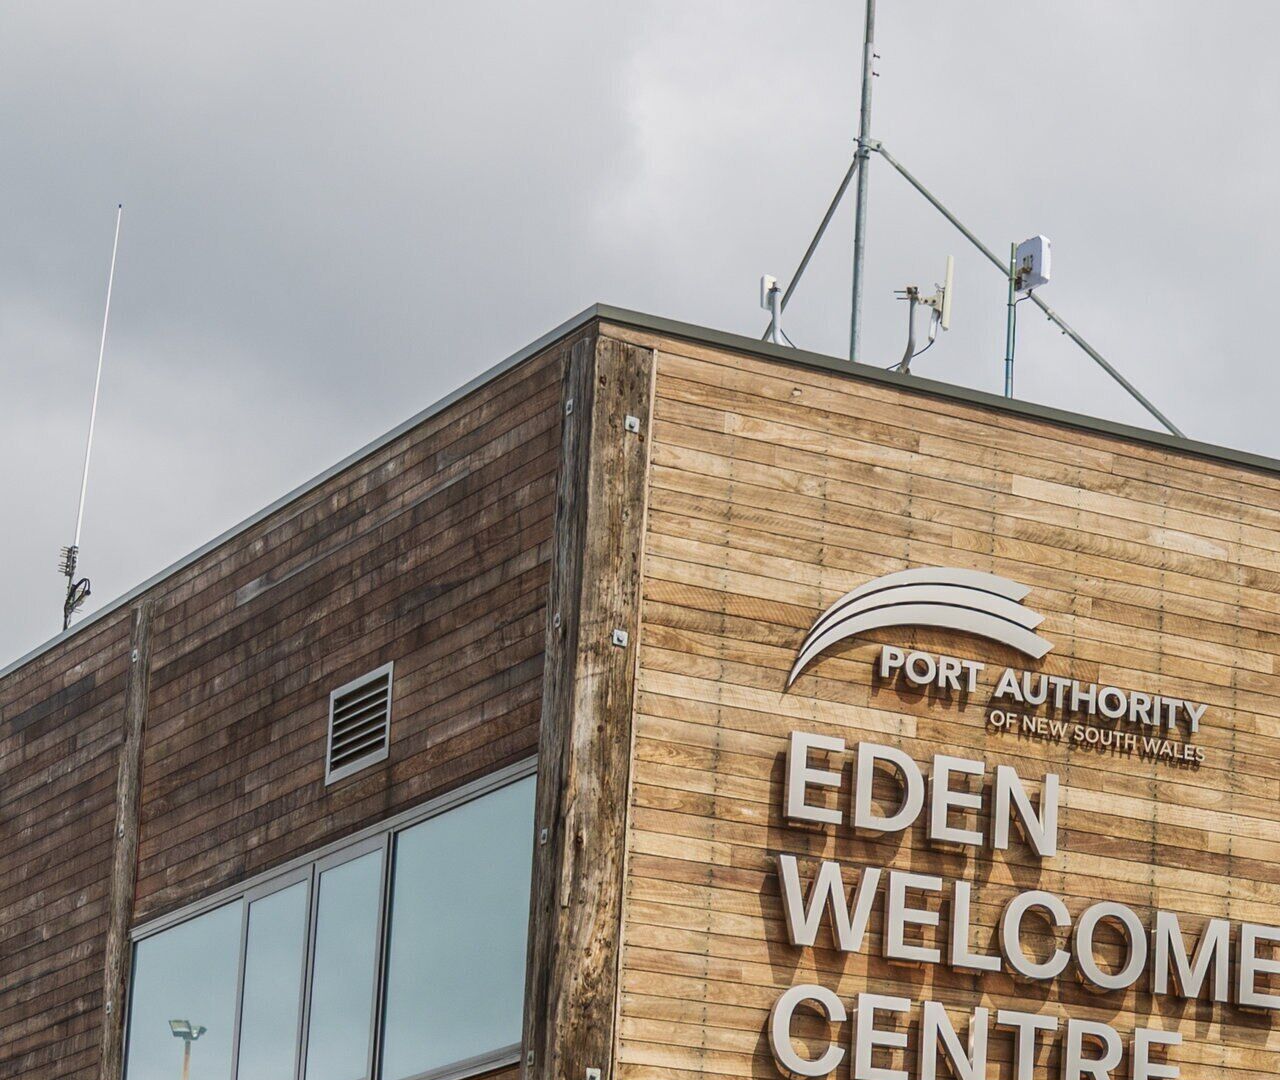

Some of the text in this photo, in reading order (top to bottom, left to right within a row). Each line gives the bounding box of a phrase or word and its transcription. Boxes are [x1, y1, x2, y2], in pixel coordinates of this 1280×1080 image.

[880, 646, 1208, 733] PORT AUTHORITY
[990, 709, 1206, 762] OF NEW SOUTH WALES
[783, 731, 1060, 857] EDEN
